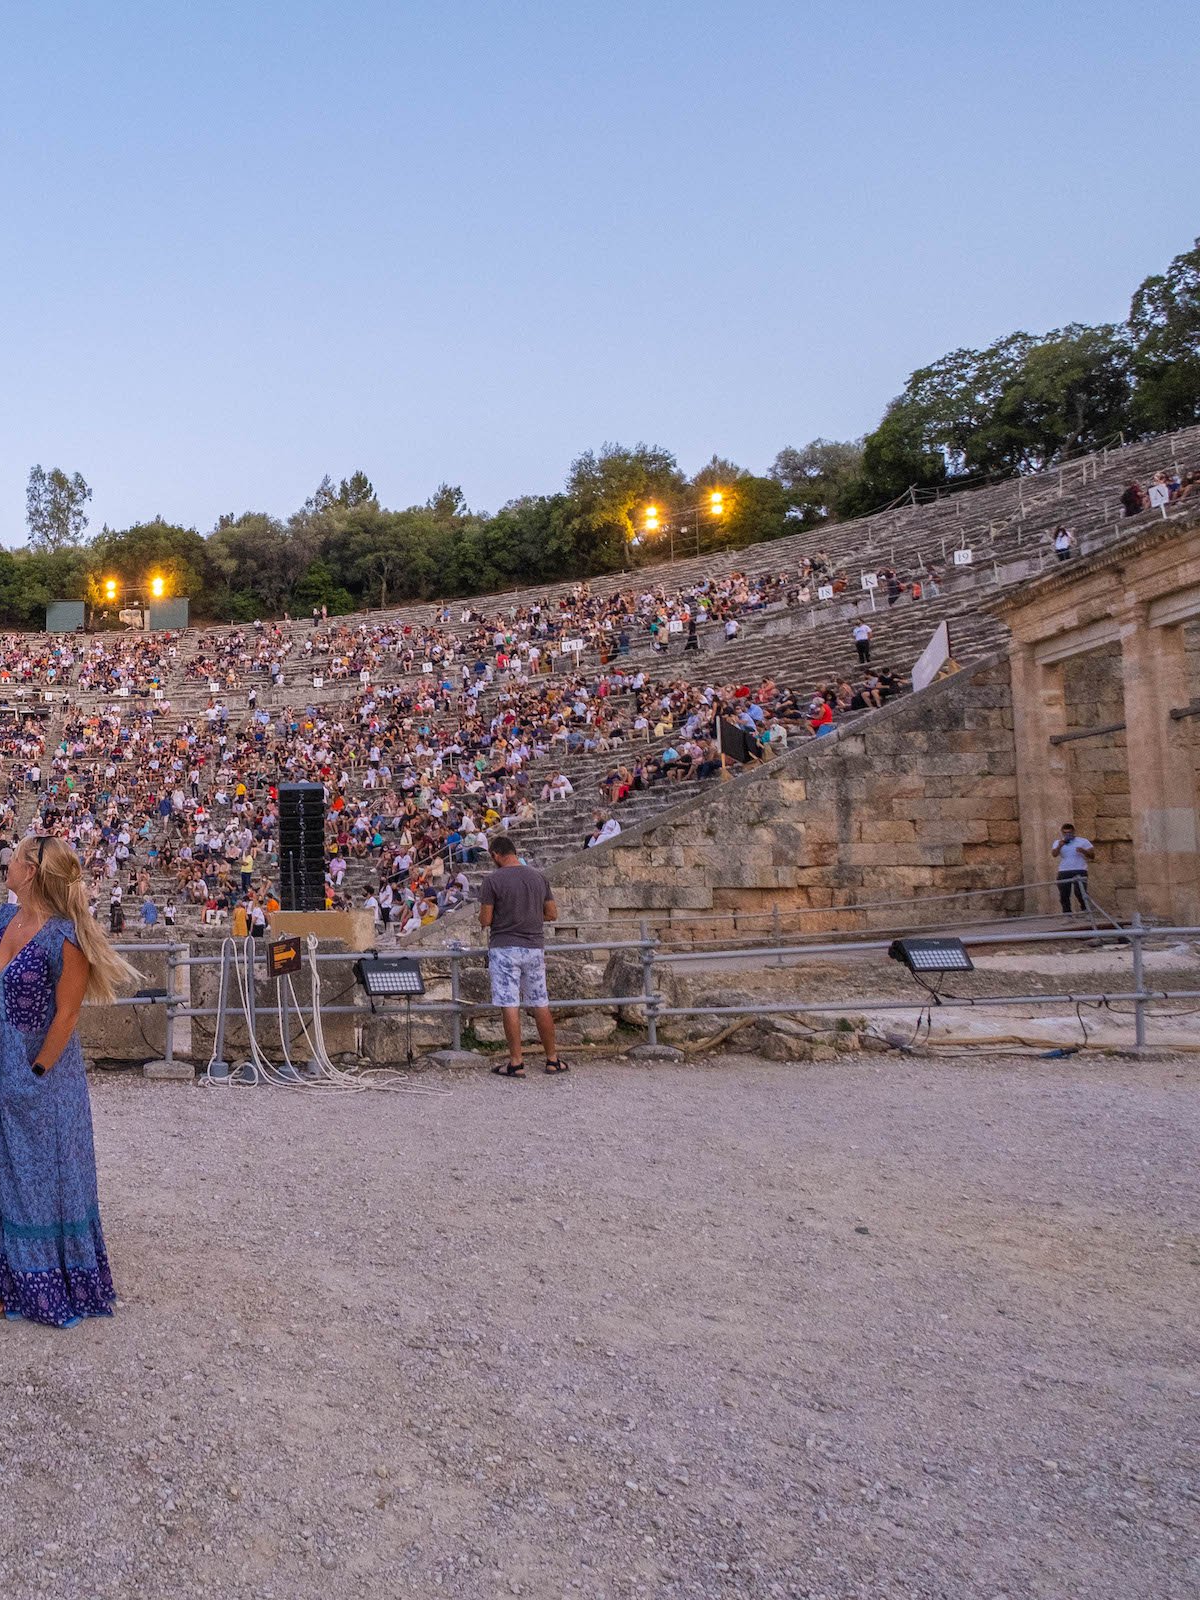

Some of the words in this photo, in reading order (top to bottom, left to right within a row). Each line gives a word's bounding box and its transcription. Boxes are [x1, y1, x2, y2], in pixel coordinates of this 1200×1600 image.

[958, 552, 969, 562] 19
[821, 588, 831, 597] 18
[672, 622, 680, 630] 17
[424, 663, 431, 671] 15
